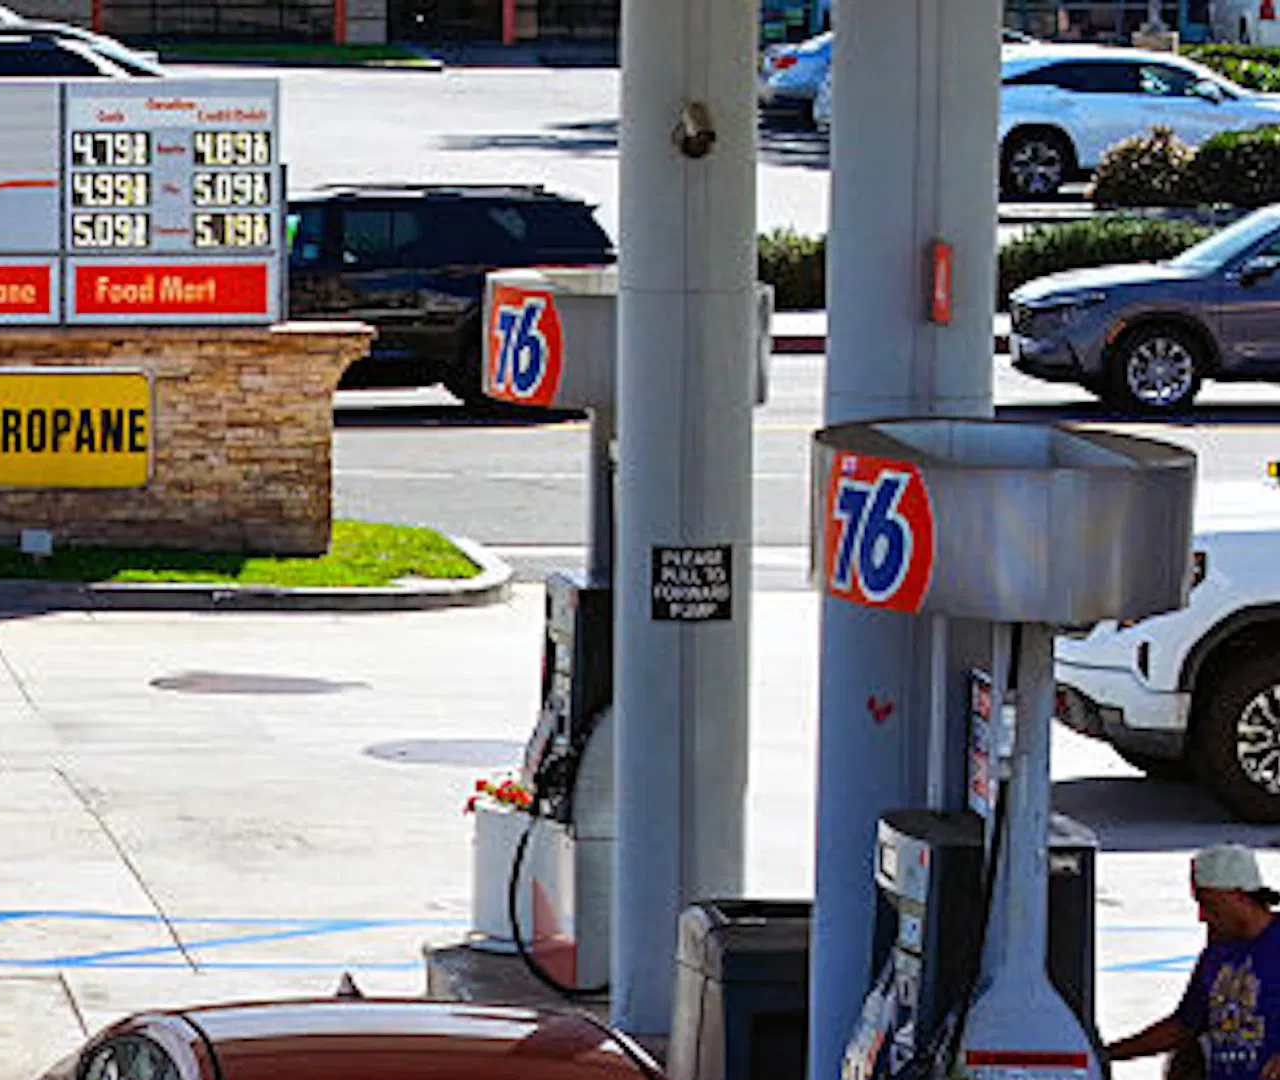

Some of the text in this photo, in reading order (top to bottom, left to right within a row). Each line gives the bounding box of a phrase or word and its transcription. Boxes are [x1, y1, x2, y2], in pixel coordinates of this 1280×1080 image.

[96, 275, 217, 302] Food Mart
[494, 297, 550, 397] 76
[832, 469, 915, 602] 76
